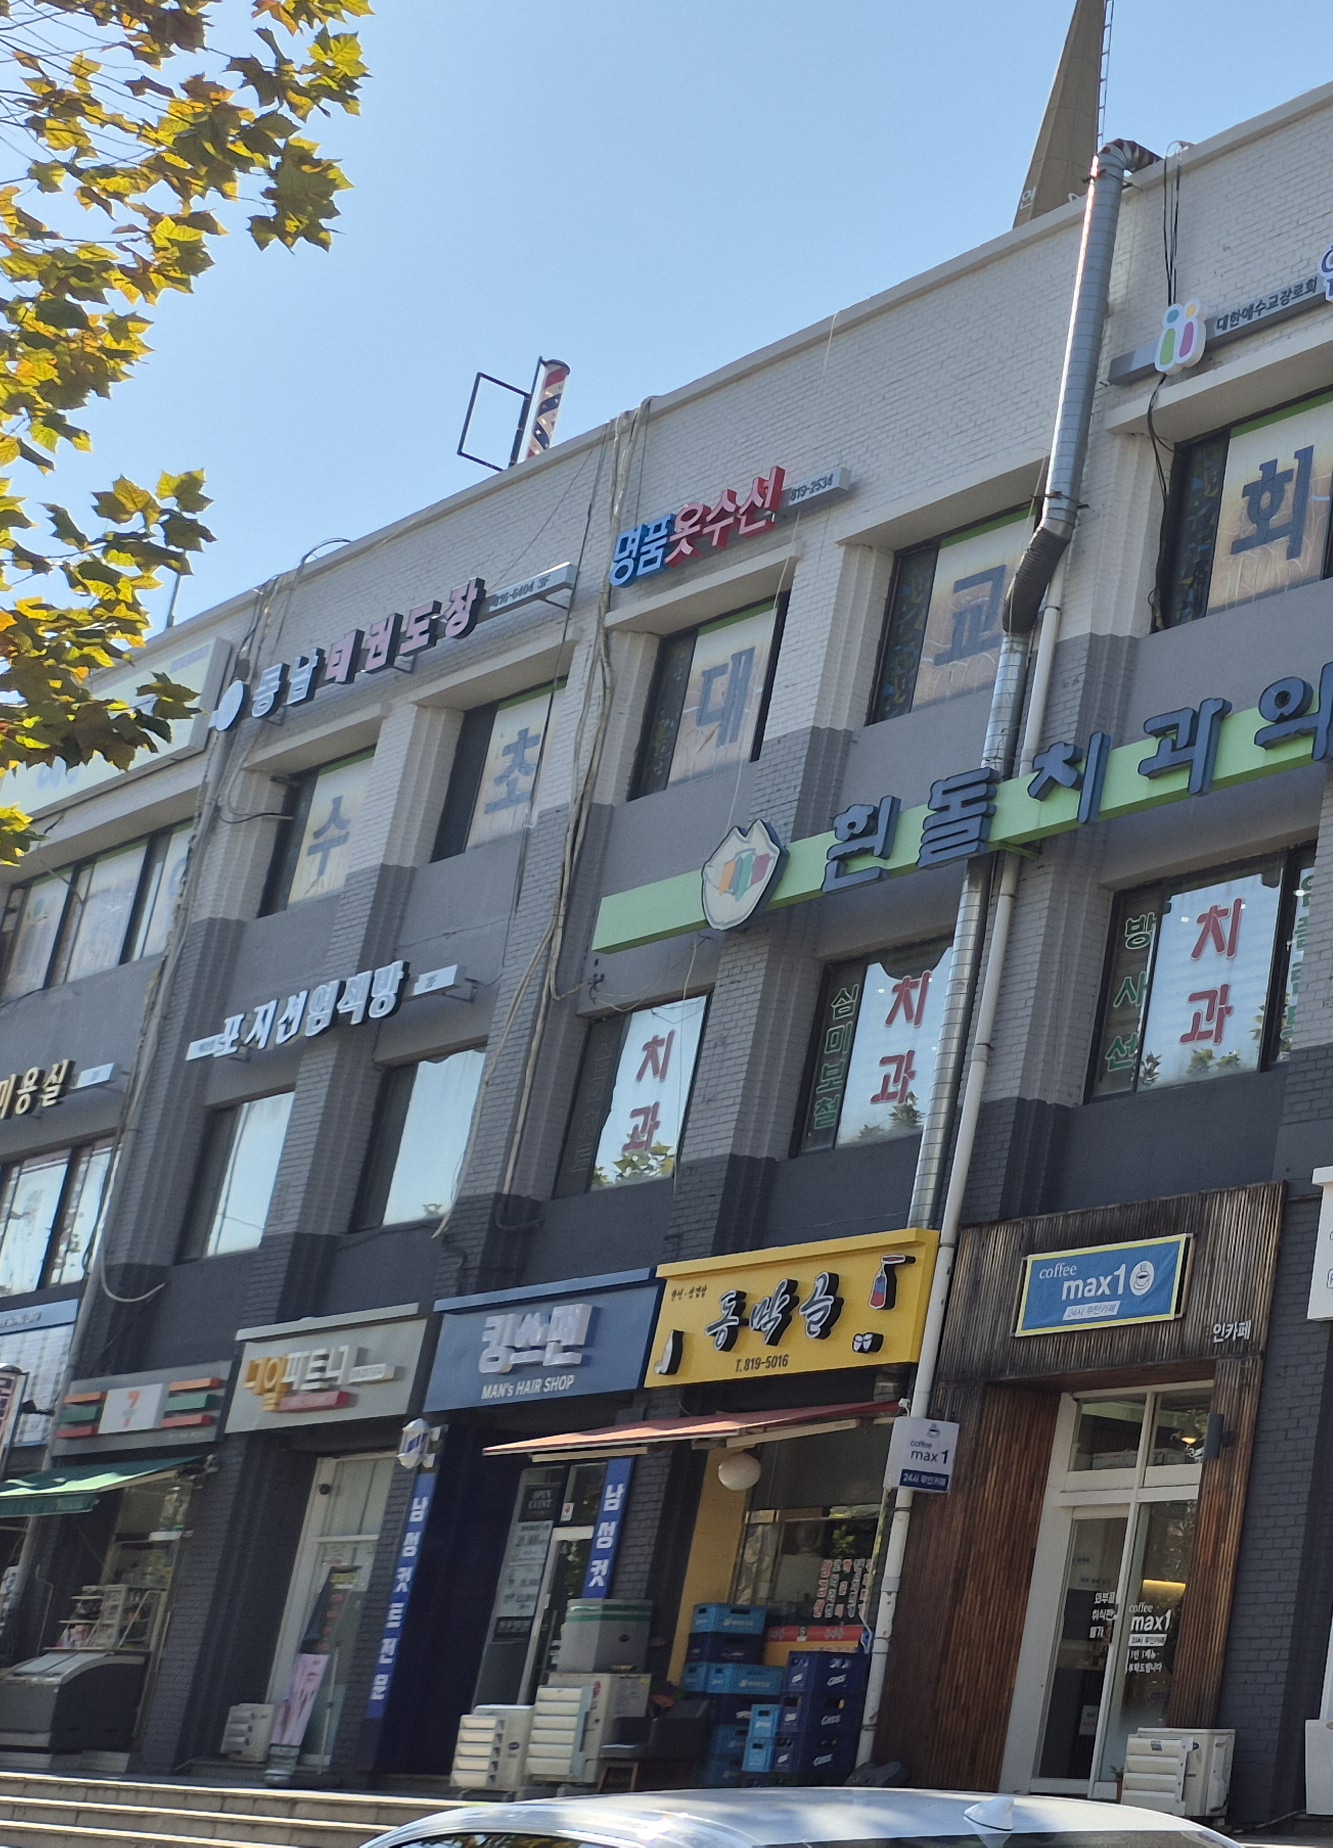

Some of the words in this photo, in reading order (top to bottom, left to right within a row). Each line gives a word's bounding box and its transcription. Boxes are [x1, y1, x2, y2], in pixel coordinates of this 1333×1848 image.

[610, 466, 785, 588] 명품옷수선
[1232, 443, 1314, 561] 회
[932, 568, 1001, 670] 교
[695, 646, 756, 749] 대
[484, 726, 543, 815] 초
[306, 794, 353, 877] 수
[1178, 896, 1244, 1046] 치과
[869, 969, 934, 1106] 치과
[621, 1029, 678, 1155] 치과
[1037, 1261, 1077, 1281] coffee
[1061, 1263, 1127, 1301] max1
[480, 1383, 514, 1401] MAN's
[515, 1379, 543, 1396] HAIR
[544, 1374, 575, 1393] SHOP
[909, 1439, 933, 1450] coffee
[370, 1496, 429, 1701] 남성컷트전문
